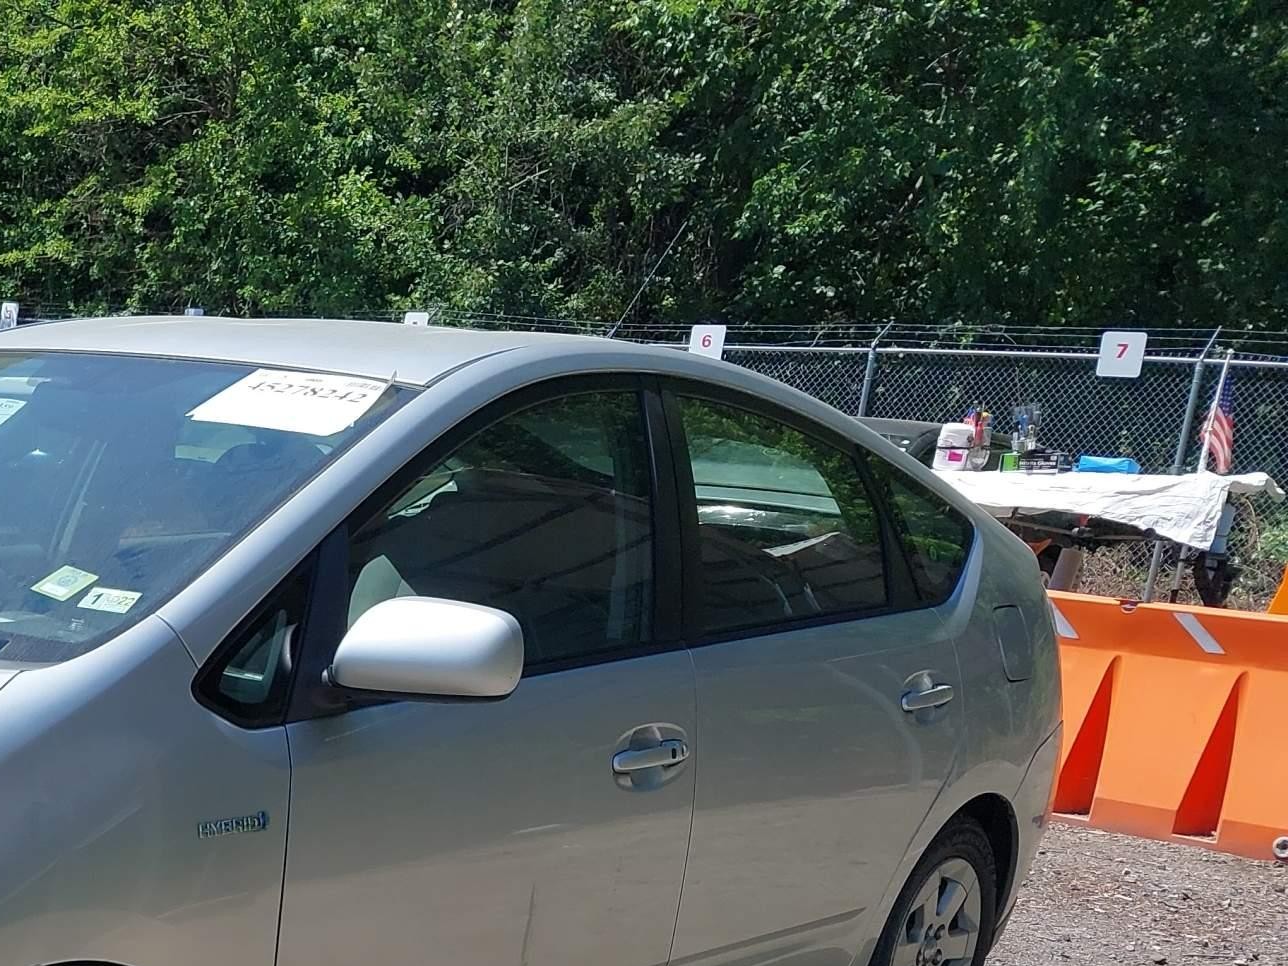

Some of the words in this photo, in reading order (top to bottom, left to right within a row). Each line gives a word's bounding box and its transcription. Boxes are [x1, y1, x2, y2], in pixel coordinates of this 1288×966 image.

[702, 334, 712, 348] 6
[1116, 343, 1129, 359] 7
[248, 381, 368, 403] 45278242
[91, 592, 104, 605] 1
[198, 816, 259, 839] HYBRID
